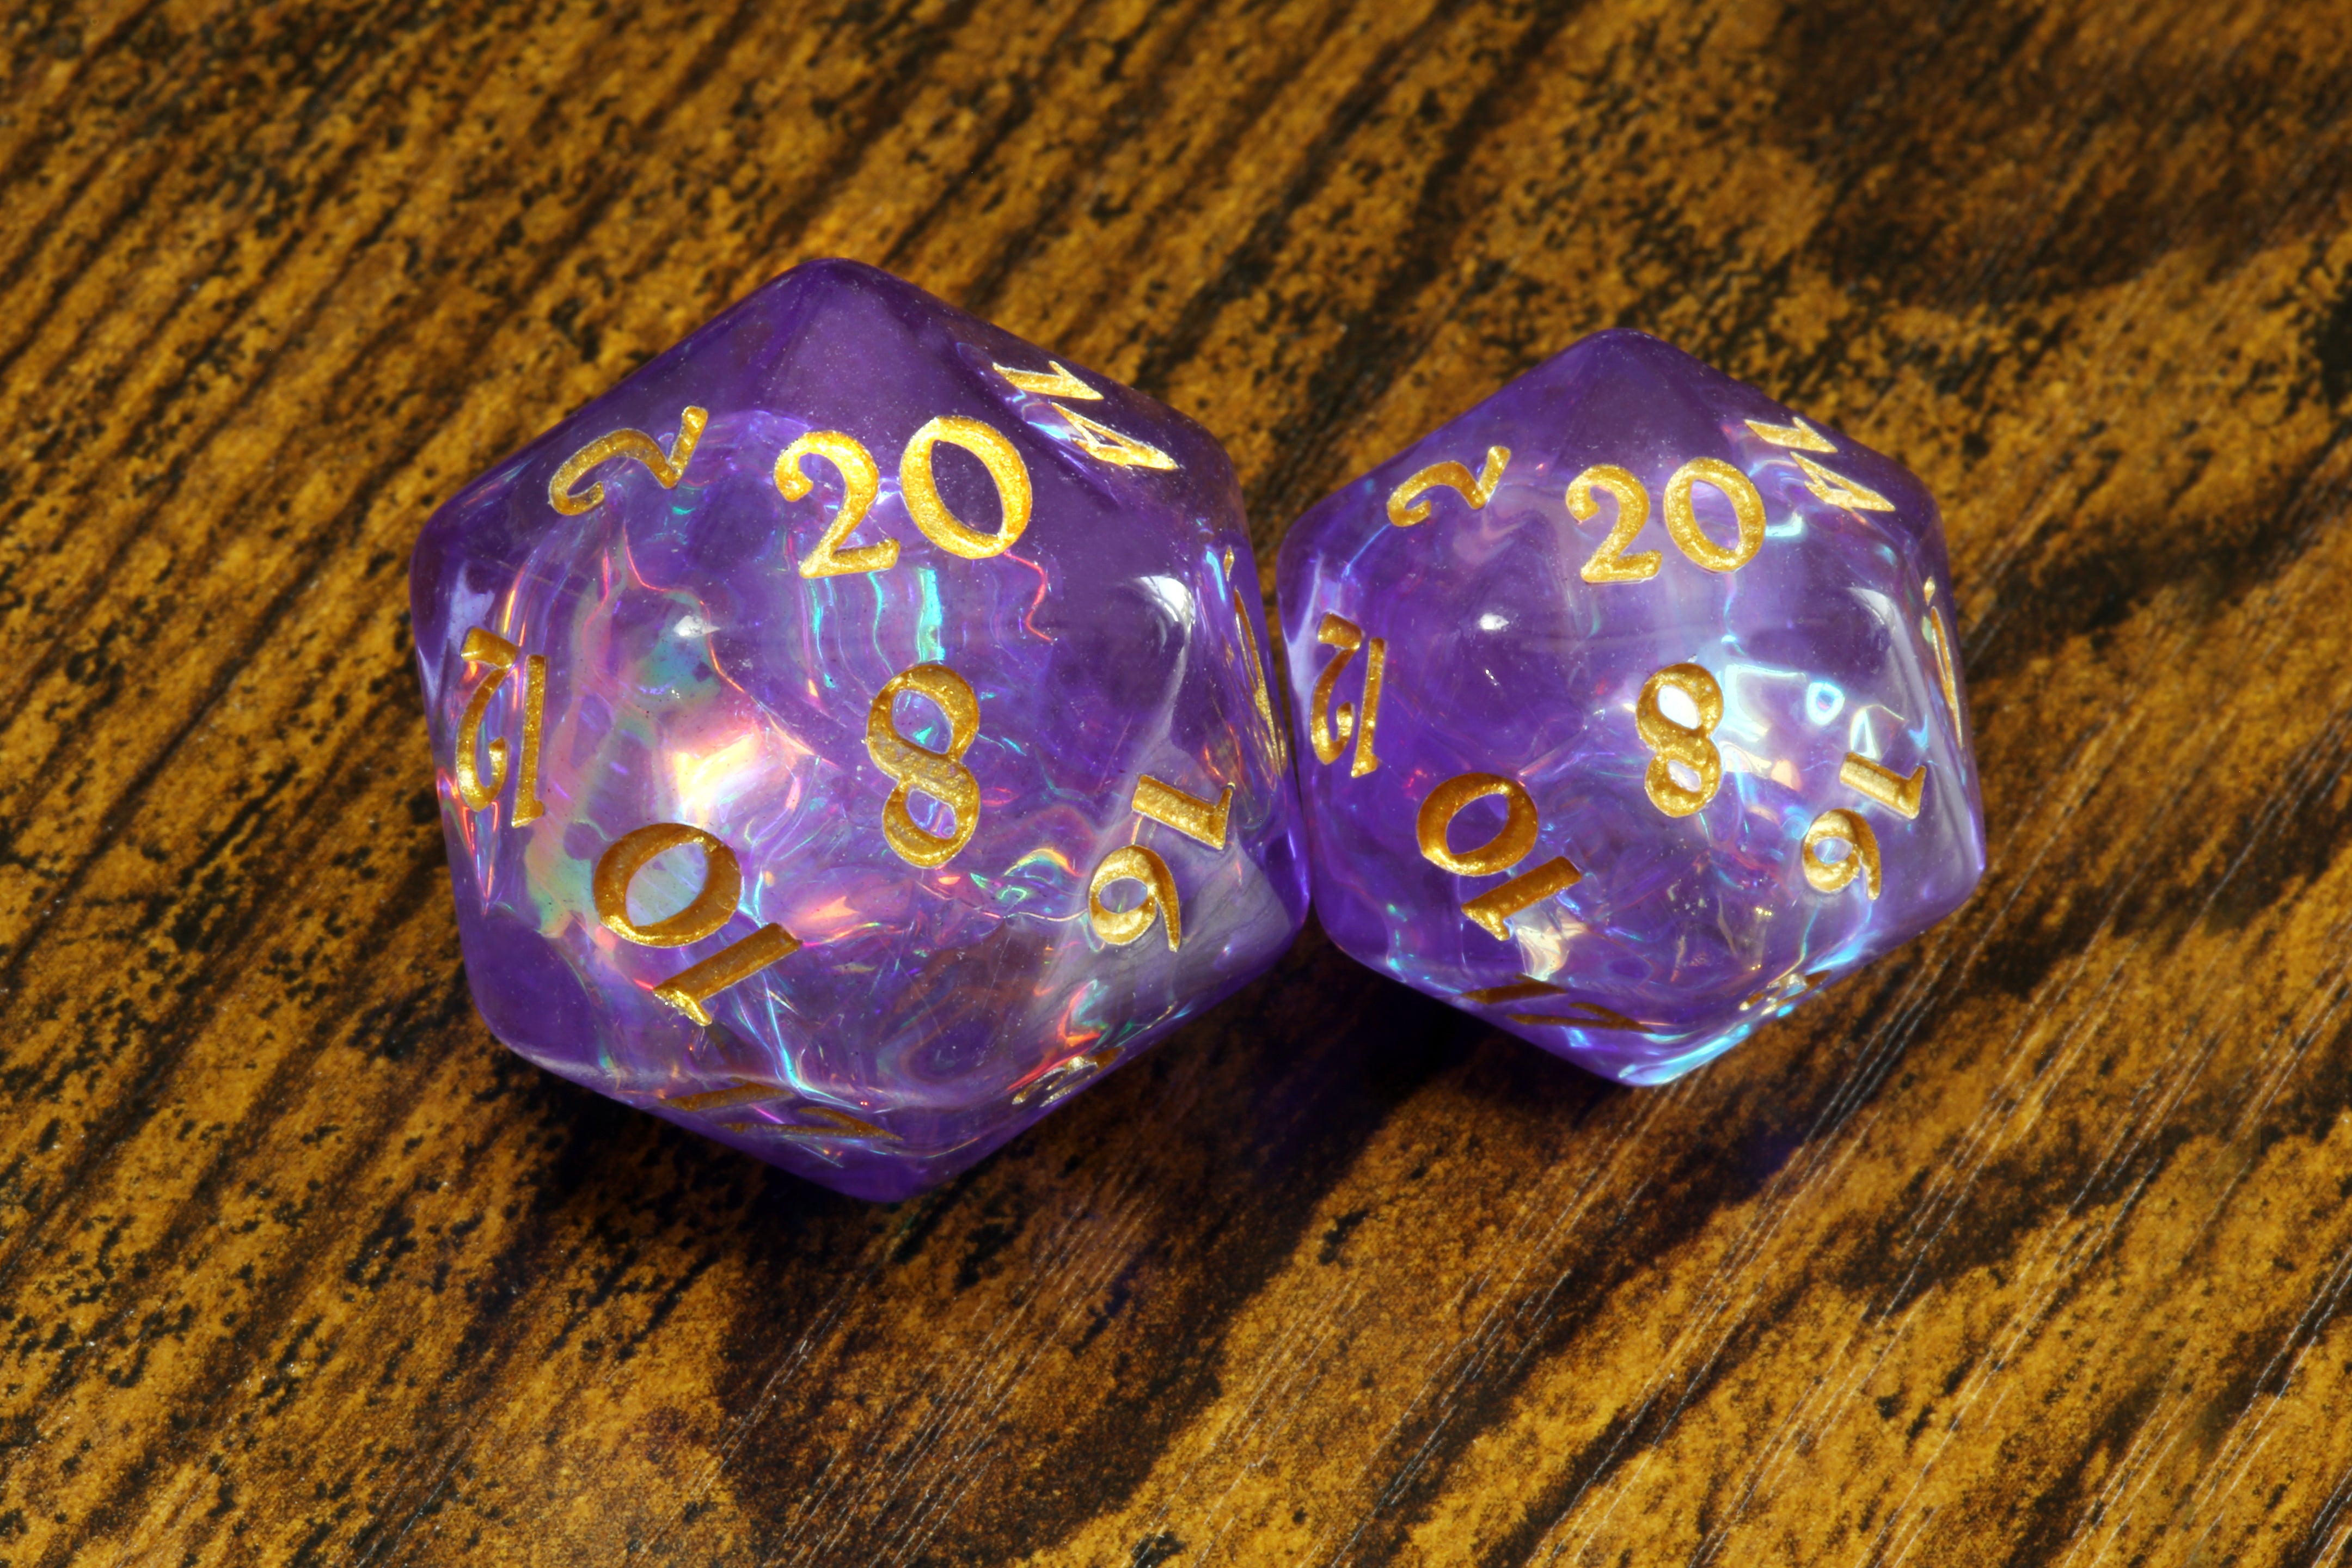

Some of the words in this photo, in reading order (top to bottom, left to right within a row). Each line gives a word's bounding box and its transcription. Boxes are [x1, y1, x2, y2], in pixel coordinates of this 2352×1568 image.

[549, 406, 708, 516] 2
[992, 360, 1179, 470] 14
[1387, 446, 1511, 527] 2
[1744, 416, 1895, 511] 14
[774, 415, 1032, 578] 20
[1565, 457, 1766, 583] 20
[456, 627, 547, 828] 12
[866, 664, 979, 869] 8
[1311, 612, 1386, 778] 12
[1636, 663, 1724, 818] 8
[1089, 774, 1235, 952] 16
[1417, 772, 1582, 941] 10
[1802, 752, 1927, 901] 16
[592, 823, 803, 1026] 10
